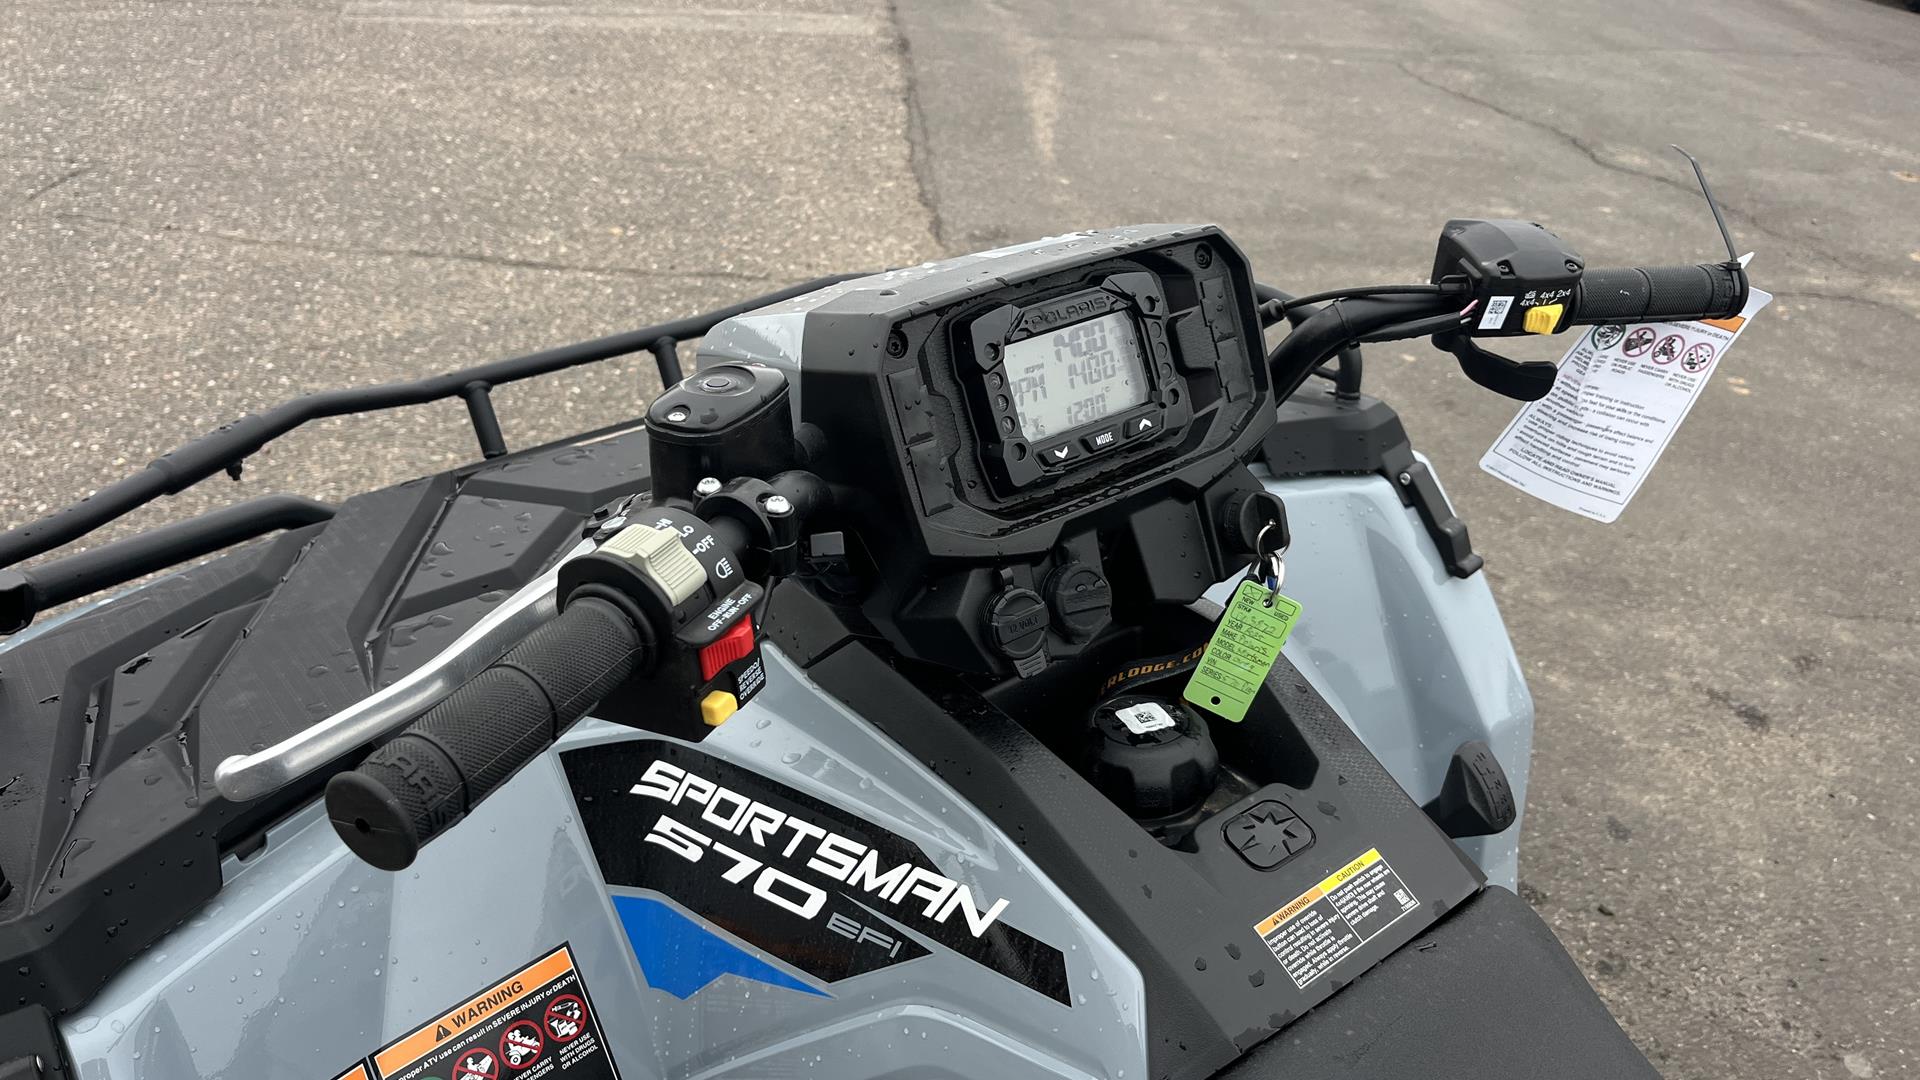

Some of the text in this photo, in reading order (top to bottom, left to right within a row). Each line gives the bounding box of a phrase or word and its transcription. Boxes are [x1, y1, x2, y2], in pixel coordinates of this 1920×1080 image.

[1031, 297, 1107, 330] POLARIS
[1095, 432, 1114, 446] MODE
[707, 597, 736, 621] ENGINE
[1241, 596, 1255, 606] NEW
[1227, 618, 1243, 631] YEAR
[1273, 611, 1289, 622] USED
[1215, 638, 1235, 652] MODEL
[1222, 628, 1238, 641] MAKE
[1206, 656, 1217, 666] VIN
[1211, 647, 1232, 661] COLOR
[739, 665, 762, 692] REVERSE
[1201, 665, 1223, 681] SERIES
[740, 672, 765, 700] OVERRIDE
[629, 759, 1011, 939] SPORTSMAN
[643, 814, 827, 921] 570
[1336, 861, 1365, 882] CAUTION
[1278, 896, 1311, 922] WARNING
[826, 911, 903, 959] EFI
[451, 981, 524, 1028] WARNING
[423, 1056, 439, 1070] ATV
[438, 1049, 453, 1060] use
[452, 1040, 466, 1052] can
[466, 1027, 486, 1044] result
[485, 1024, 493, 1032] in
[493, 1007, 521, 1028] SEVERE
[520, 992, 545, 1012] INJURY
[545, 987, 553, 996] or
[552, 974, 576, 993] DEATH
[559, 1032, 592, 1056] NEVER USE
[559, 1037, 595, 1062] WITH DRUGS
[531, 1056, 553, 1072] CARRY
[561, 1046, 599, 1070] OR ALCOHOL
